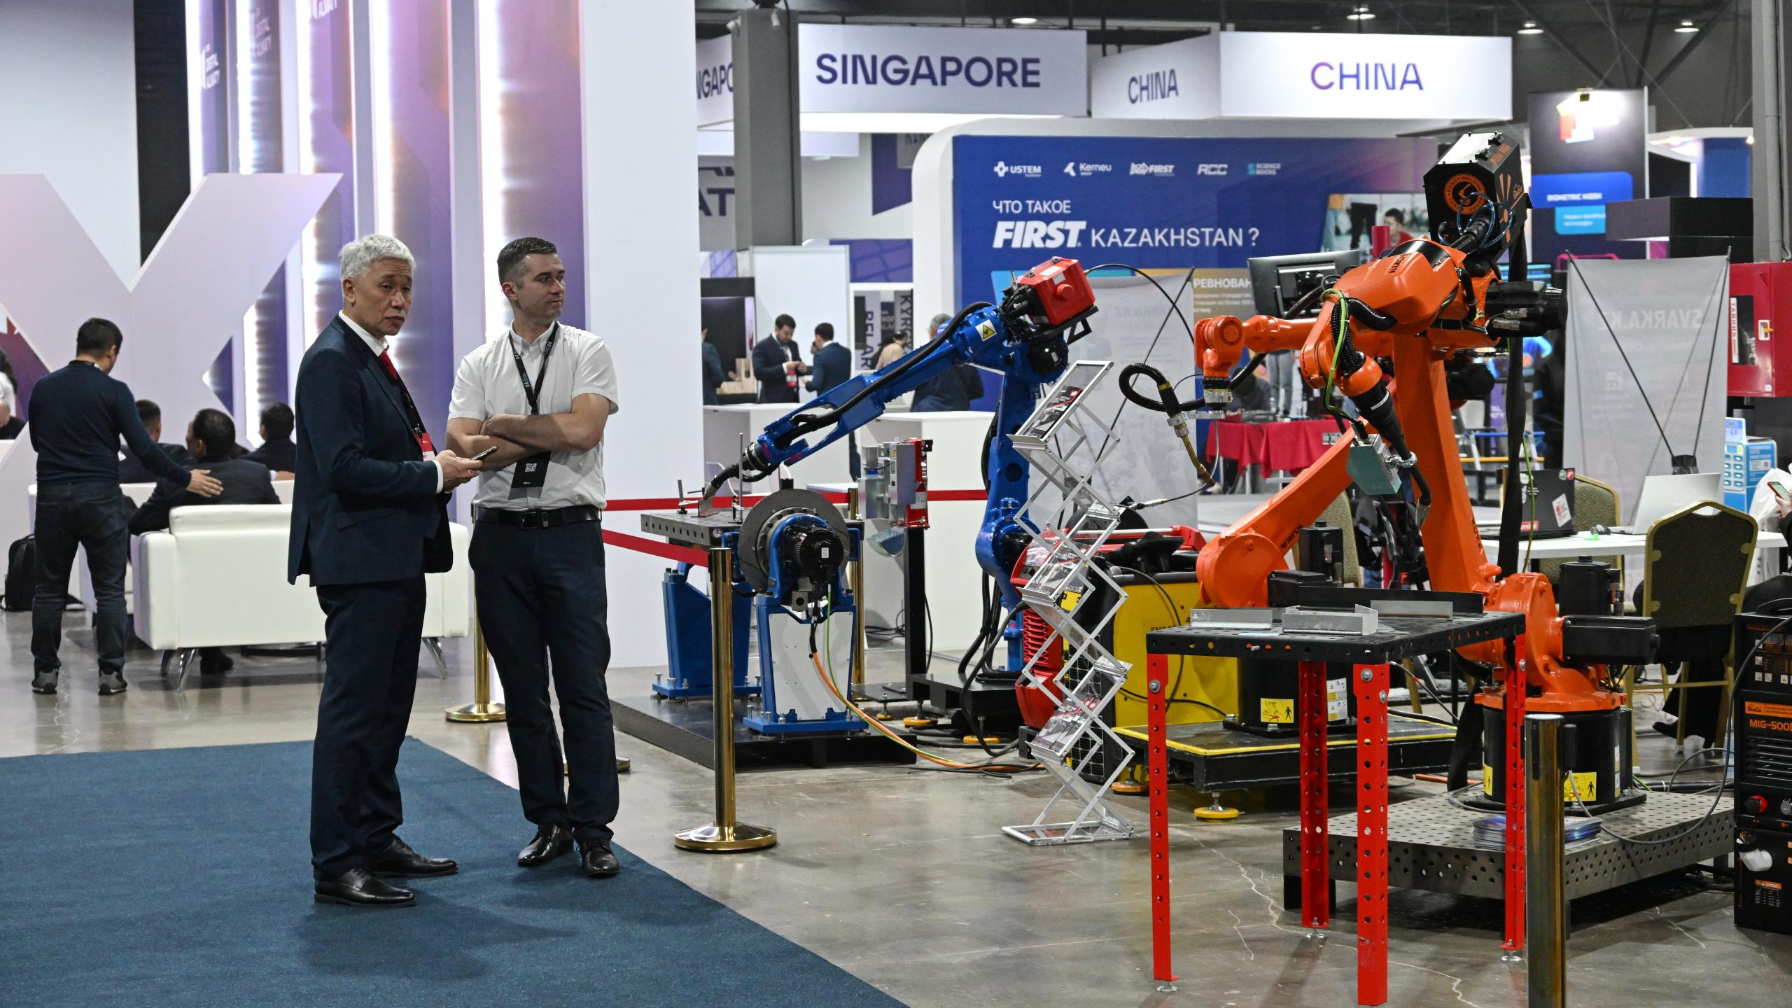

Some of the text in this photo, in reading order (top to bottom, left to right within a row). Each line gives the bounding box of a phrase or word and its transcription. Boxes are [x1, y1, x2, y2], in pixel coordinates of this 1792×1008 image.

[815, 52, 1041, 88] SINGAPORE
[1310, 61, 1424, 91] CHINA
[1127, 68, 1179, 104] CHINA
[1010, 165, 1042, 174] USTEM
[992, 200, 1071, 213] ЧТО ТАКОЕ
[1091, 228, 1243, 247] KAZAKHSTAN
[1249, 227, 1260, 246] ?
